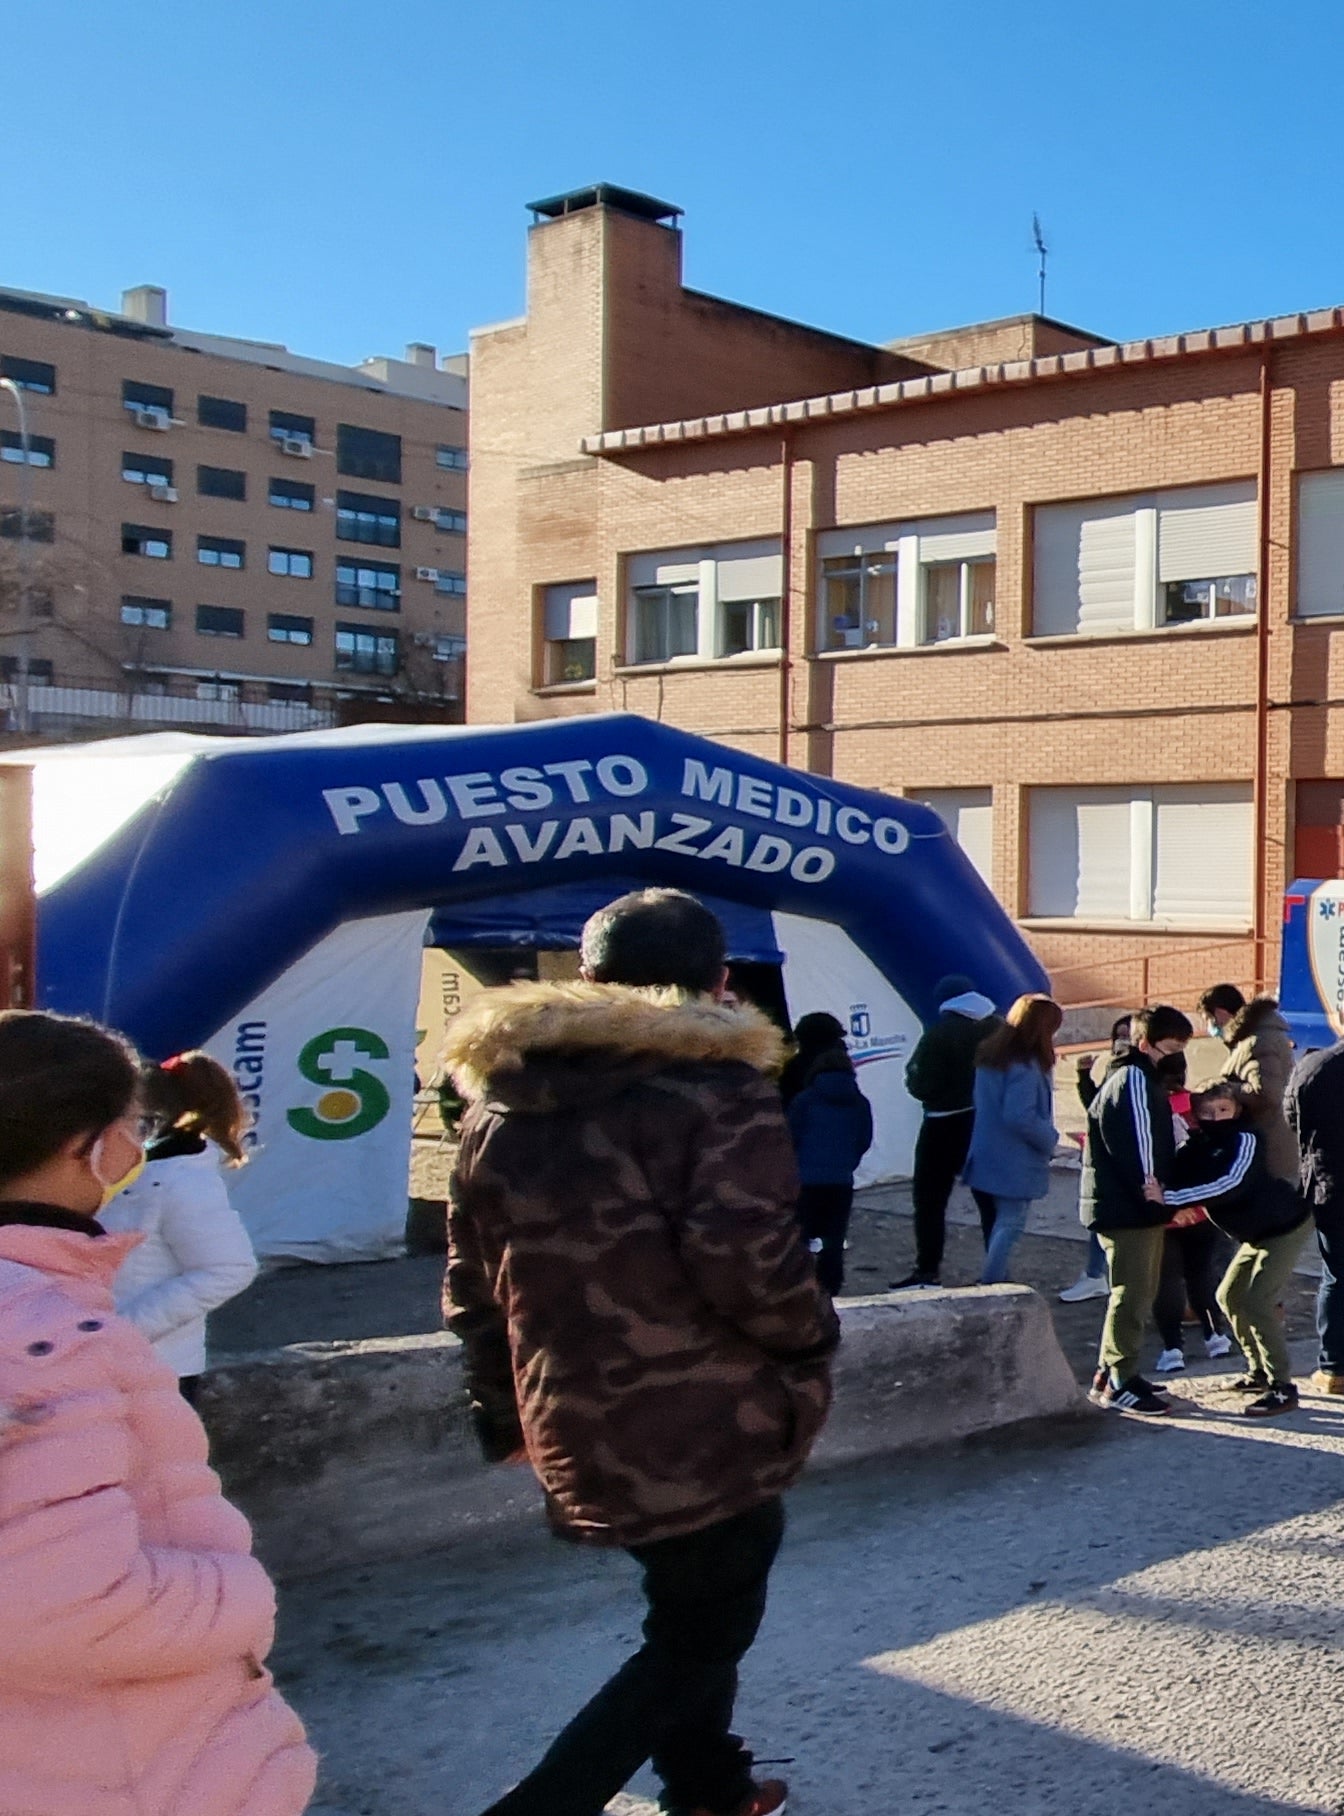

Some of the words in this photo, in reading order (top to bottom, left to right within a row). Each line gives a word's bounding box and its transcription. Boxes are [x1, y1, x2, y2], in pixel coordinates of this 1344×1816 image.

[322, 754, 648, 835] PUESTO
[681, 757, 909, 854] MEDICO
[452, 810, 835, 883] AVANZADO
